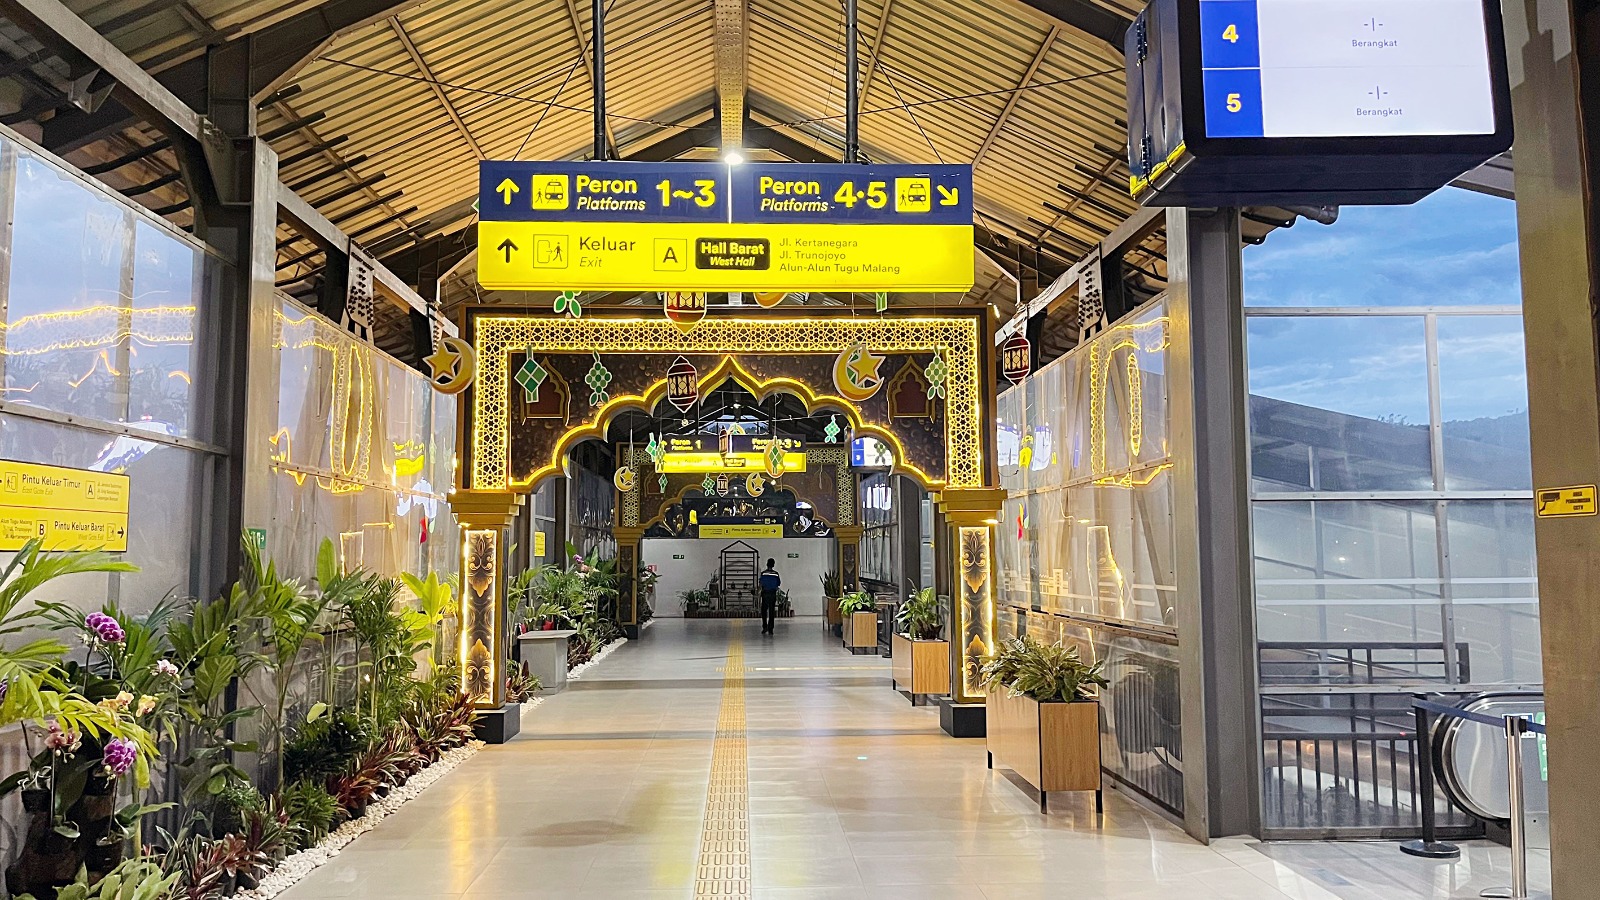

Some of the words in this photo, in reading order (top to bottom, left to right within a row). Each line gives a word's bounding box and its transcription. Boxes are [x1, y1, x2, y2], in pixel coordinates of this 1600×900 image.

[1222, 24, 1239, 43] 4
[1351, 39, 1398, 48] Berangkat
[1226, 94, 1242, 112] 5
[1356, 107, 1402, 117] Berangkat
[576, 175, 638, 193] Peron
[759, 176, 820, 195] Peron
[576, 196, 646, 211] Platforms
[760, 198, 829, 212] Platforms
[579, 236, 636, 251] Keluar
[701, 242, 727, 254] Hall
[730, 242, 765, 255] Barat
[779, 238, 792, 247] Jl.
[795, 238, 858, 249] Kertanegara
[662, 246, 678, 263] A
[779, 251, 792, 260] Jl.
[795, 251, 846, 262] Trunojoyo
[579, 256, 602, 268] Exit
[710, 256, 735, 266] West
[735, 256, 756, 267] Hall
[779, 263, 831, 273] Alun-Alun
[834, 264, 859, 275] Tugu
[862, 264, 900, 275] Malang
[22, 474, 40, 485] Pintu
[41, 476, 62, 487] Keluar
[63, 478, 81, 489] Timur
[87, 484, 94, 496] A
[39, 523, 45, 536] B
[54, 520, 71, 531] Pintu
[71, 521, 90, 531] Keluar
[91, 522, 105, 532] Barat
